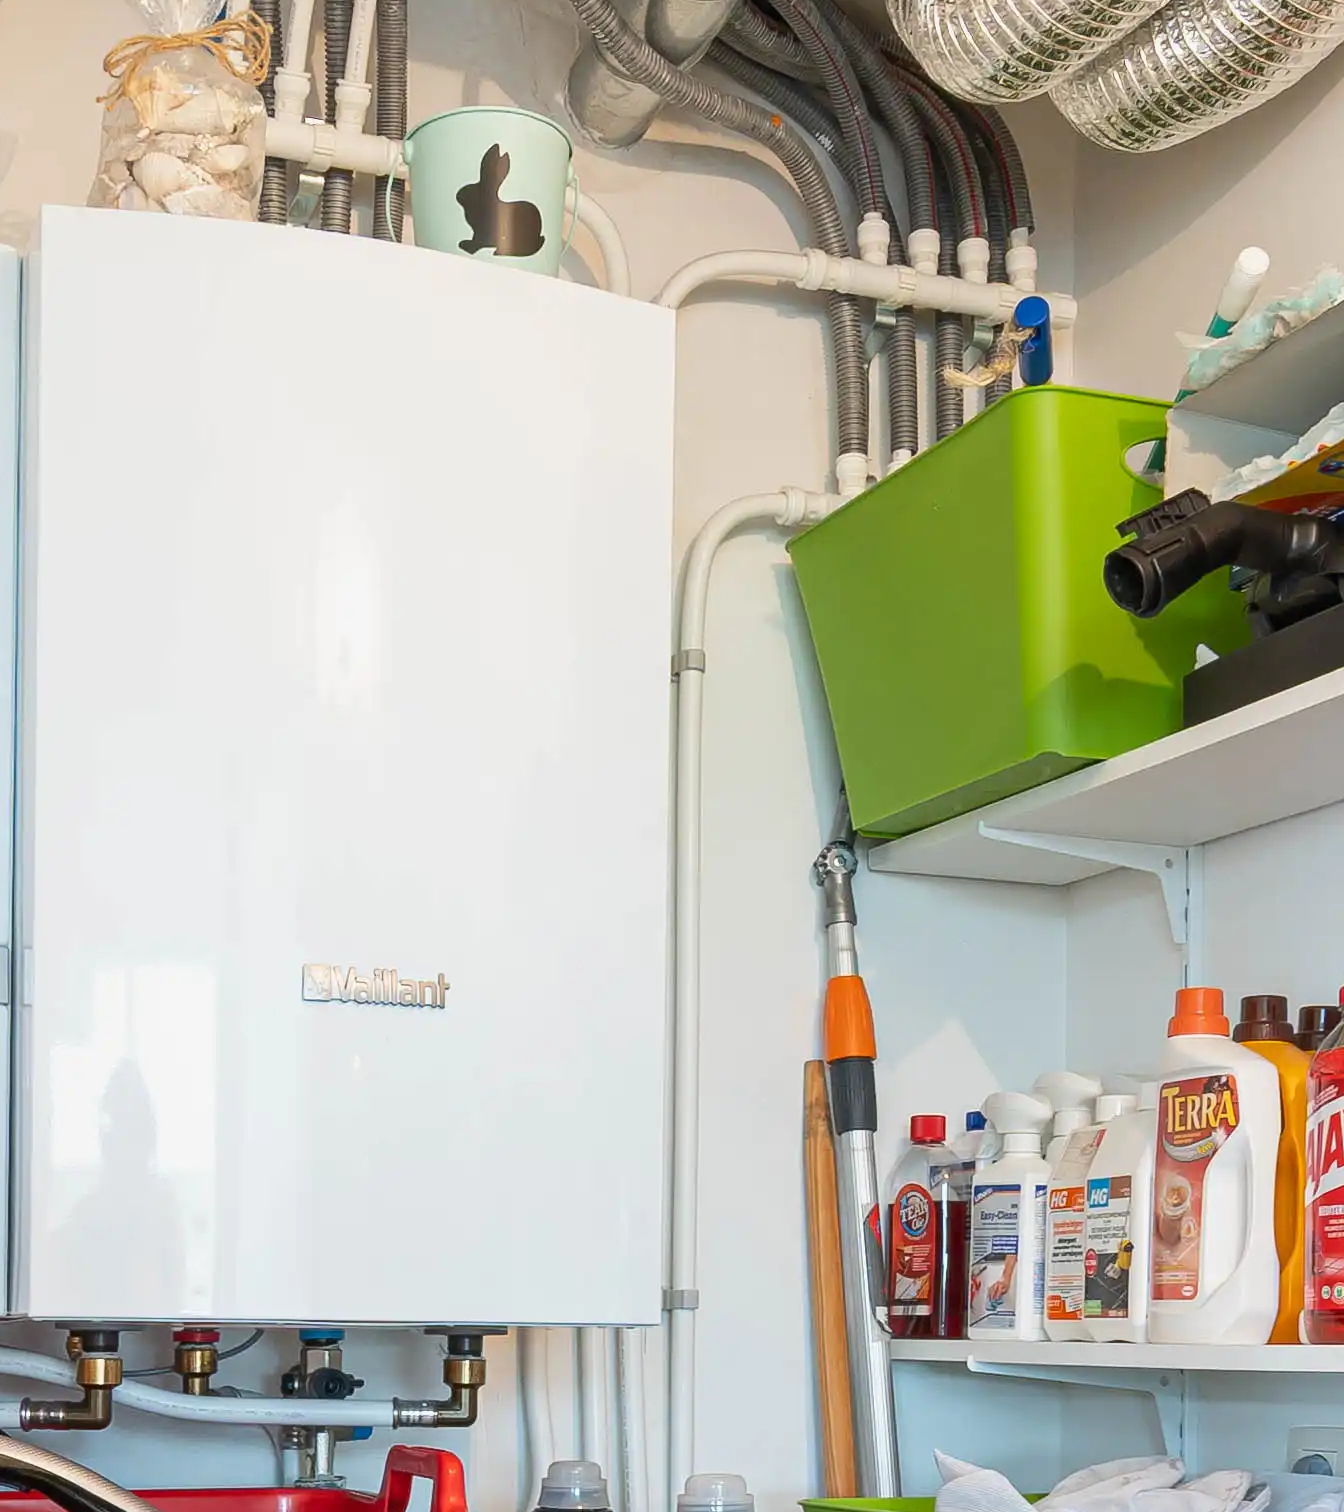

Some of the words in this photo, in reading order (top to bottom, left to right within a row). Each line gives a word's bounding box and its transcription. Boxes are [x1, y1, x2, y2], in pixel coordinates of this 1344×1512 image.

[332, 965, 451, 1009] Vaillant
[1161, 1086, 1236, 1133] TERRA
[1050, 1191, 1068, 1208] HG
[1090, 1188, 1109, 1205] HG
